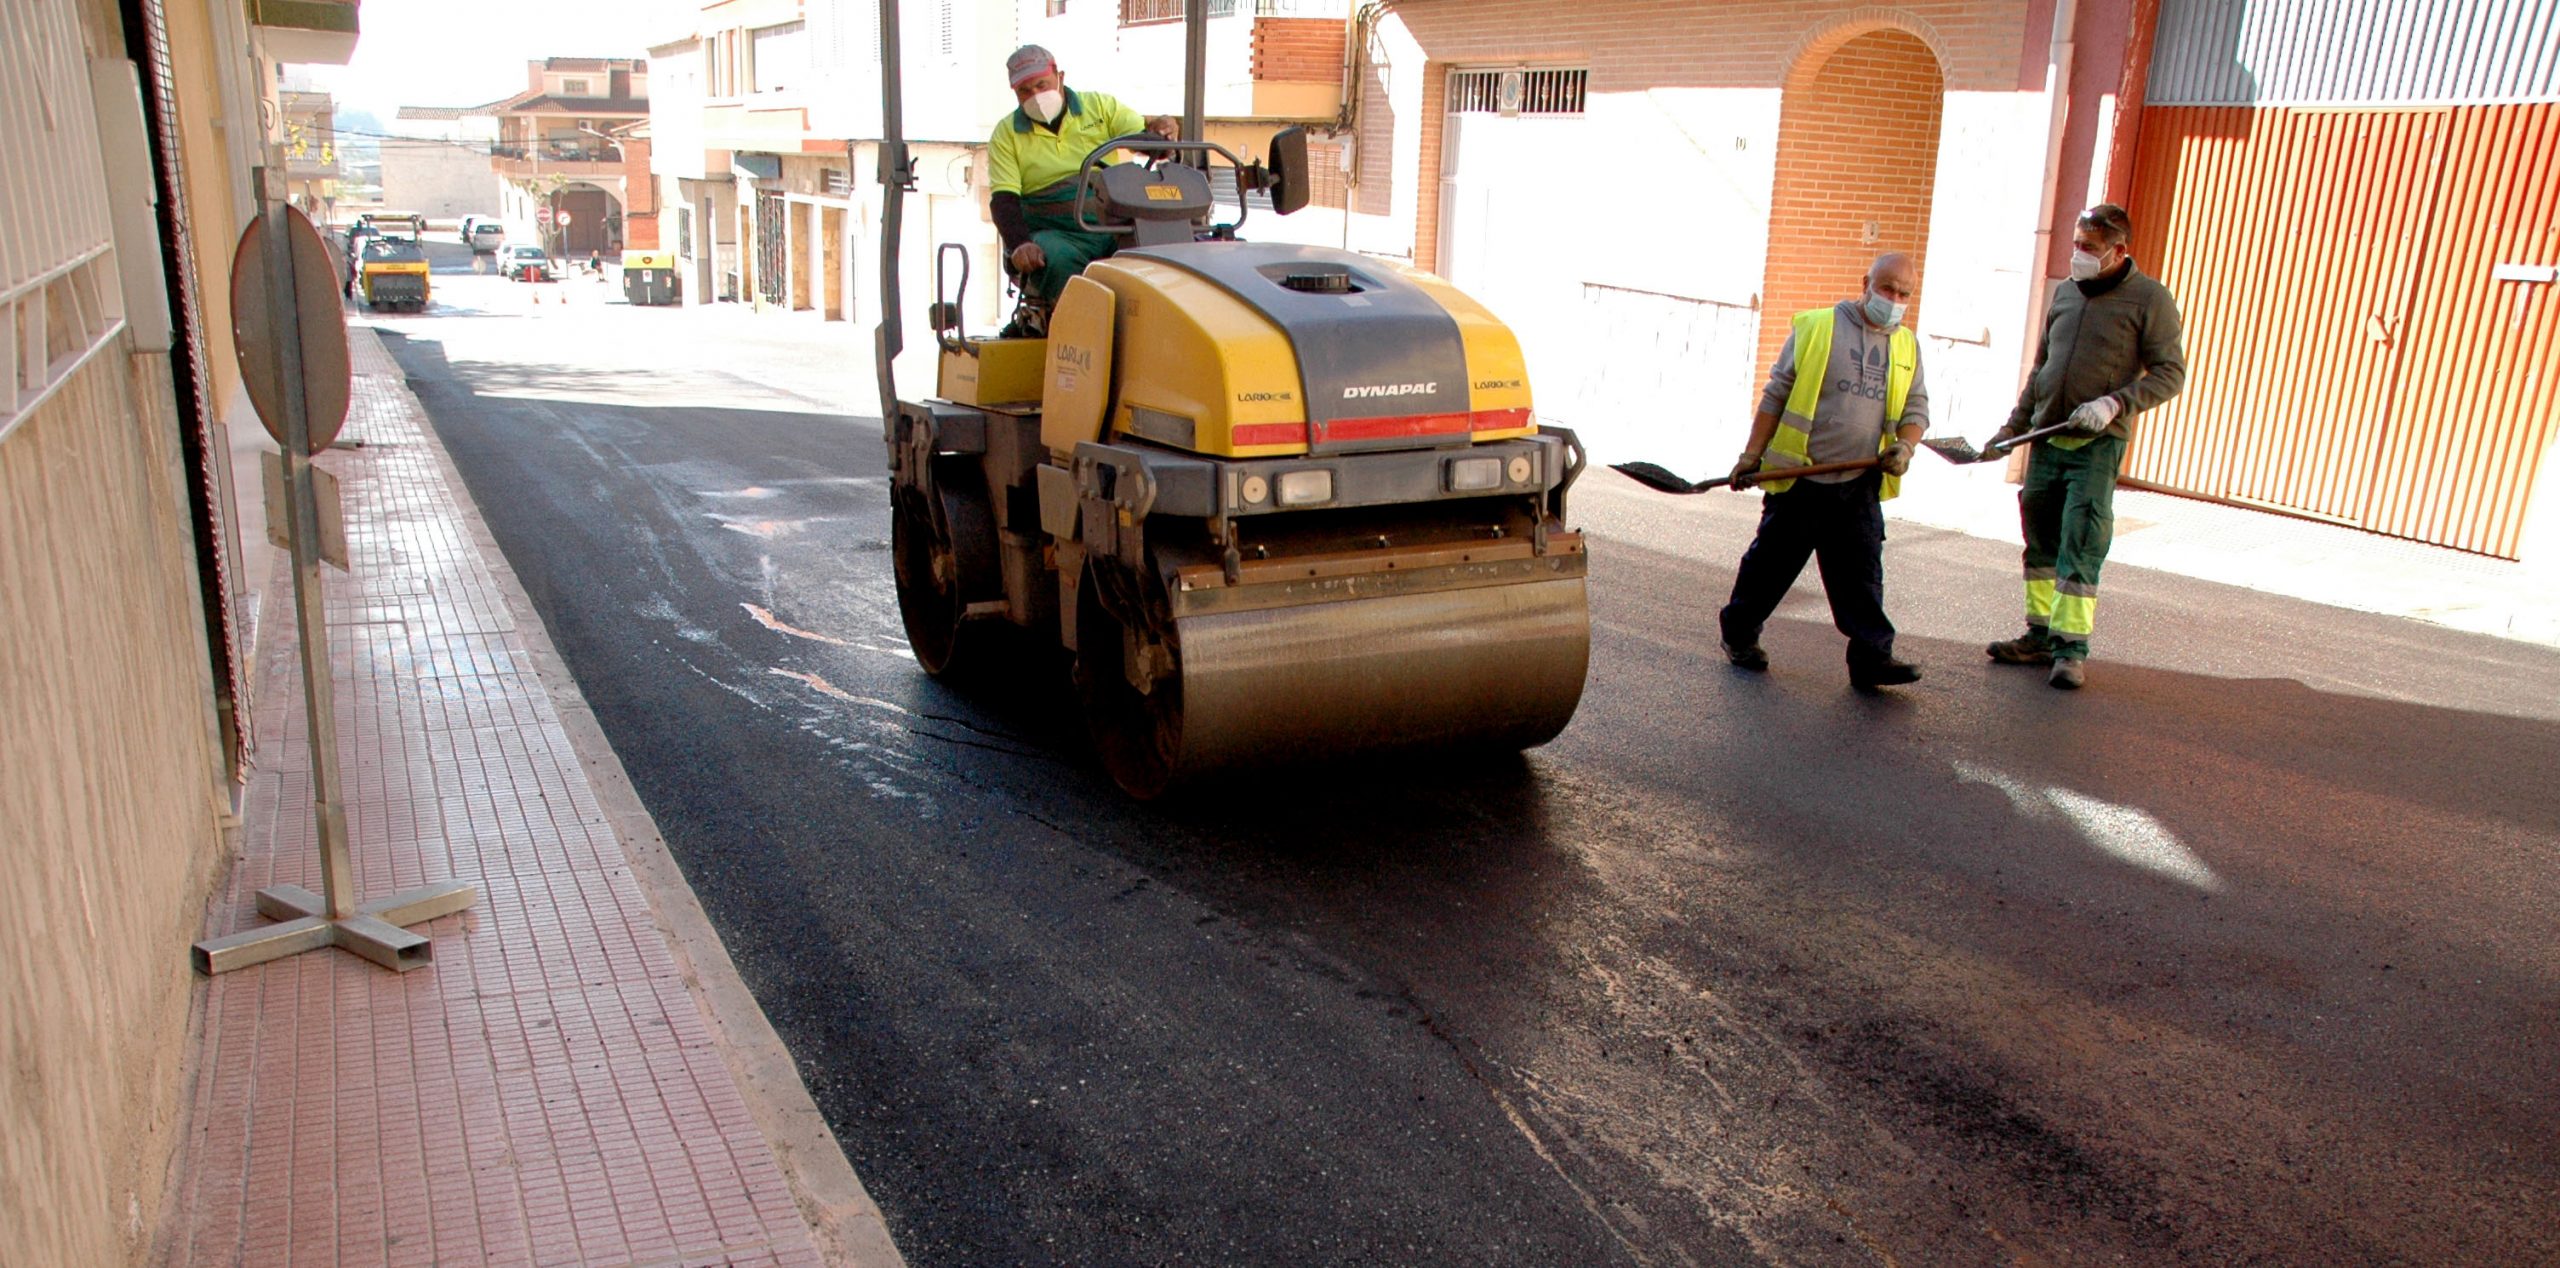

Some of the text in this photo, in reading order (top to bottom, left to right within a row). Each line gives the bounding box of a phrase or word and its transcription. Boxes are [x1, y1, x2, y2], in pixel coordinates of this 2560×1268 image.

[1237, 392, 1272, 401] LARIO
[1343, 382, 1438, 399] DYNAPAC
[1837, 379, 1887, 401] adida
